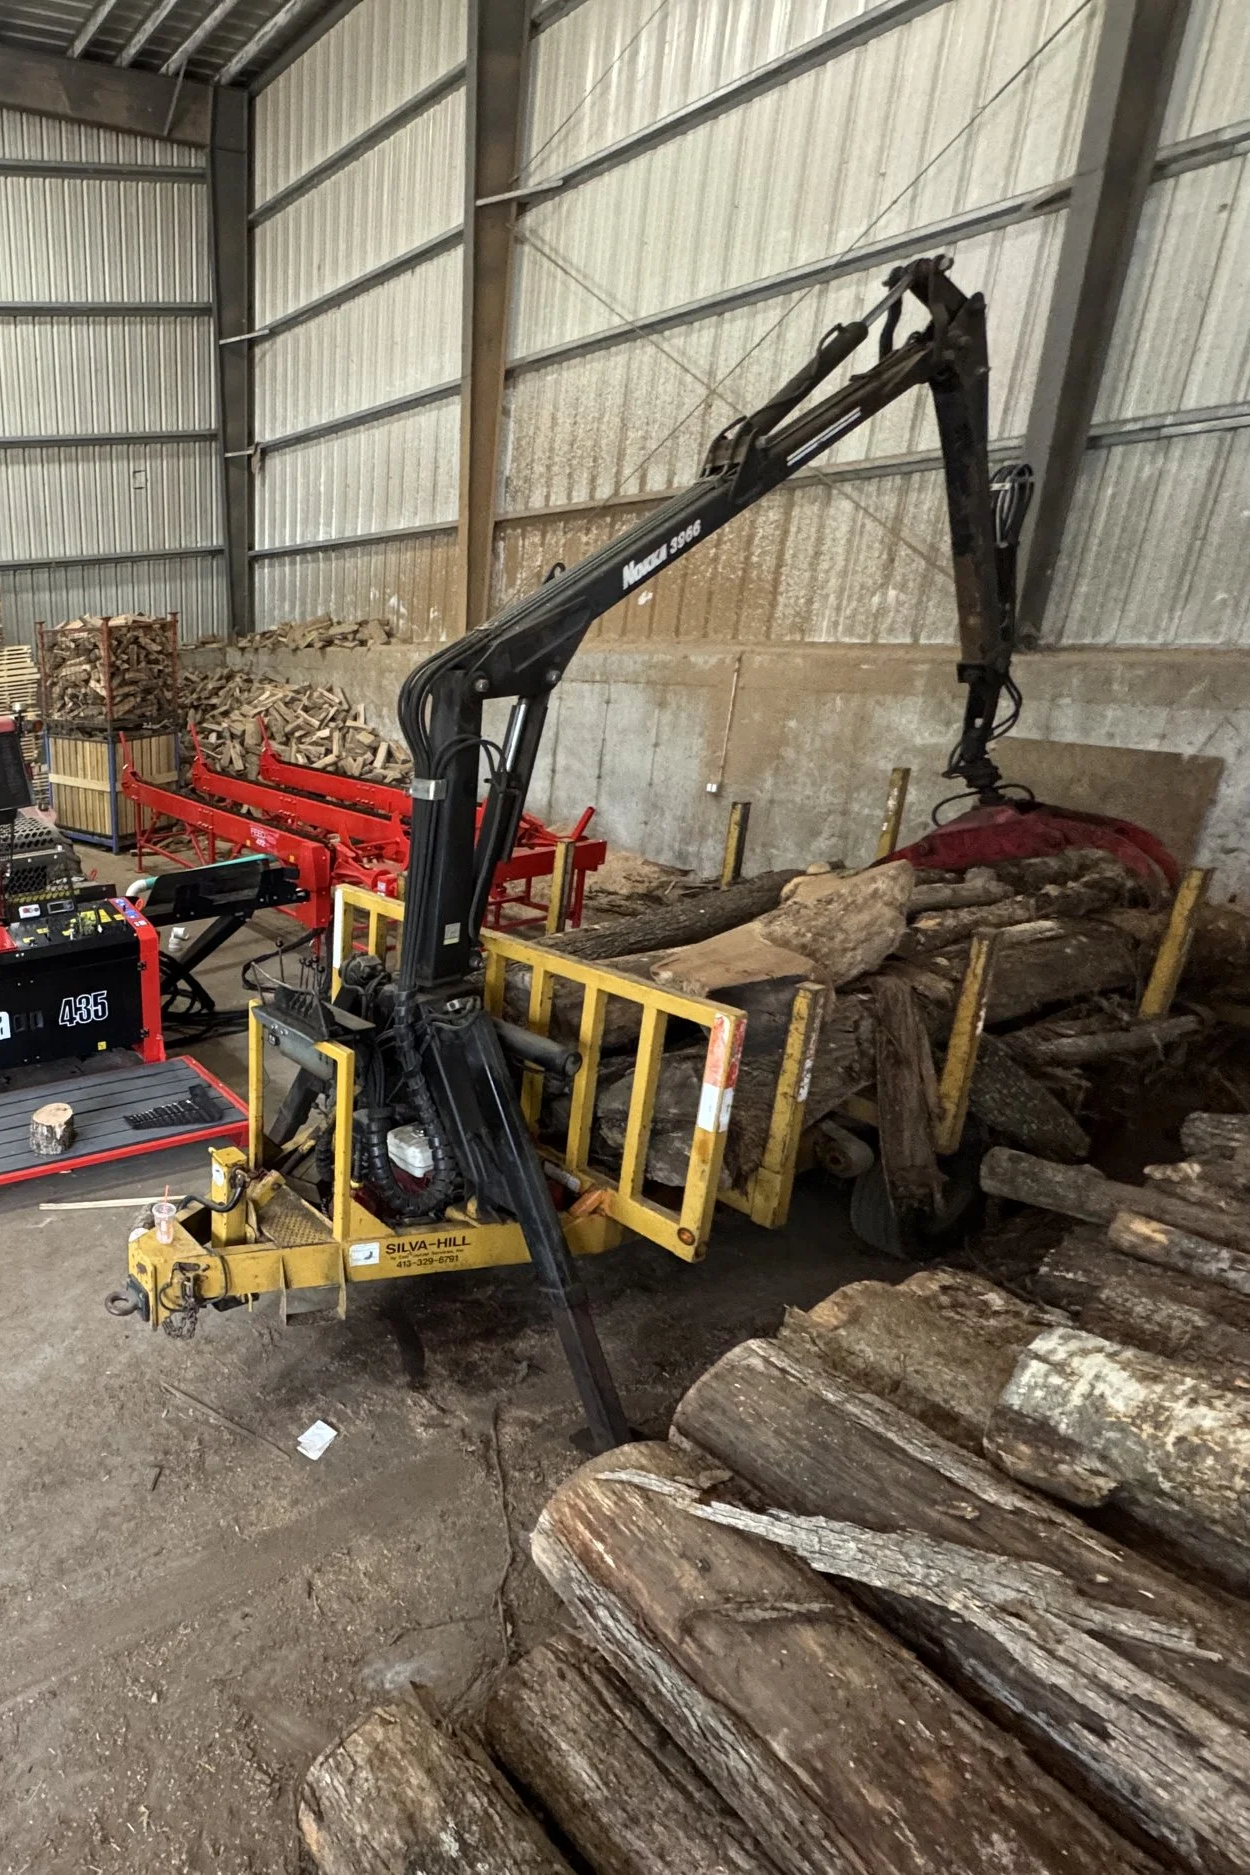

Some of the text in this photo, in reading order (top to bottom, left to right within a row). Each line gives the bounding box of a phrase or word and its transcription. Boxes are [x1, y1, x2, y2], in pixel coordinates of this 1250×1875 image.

[670, 519, 701, 554] 3966
[58, 990, 109, 1027] 435
[385, 1236, 471, 1254] SILVA-HILL
